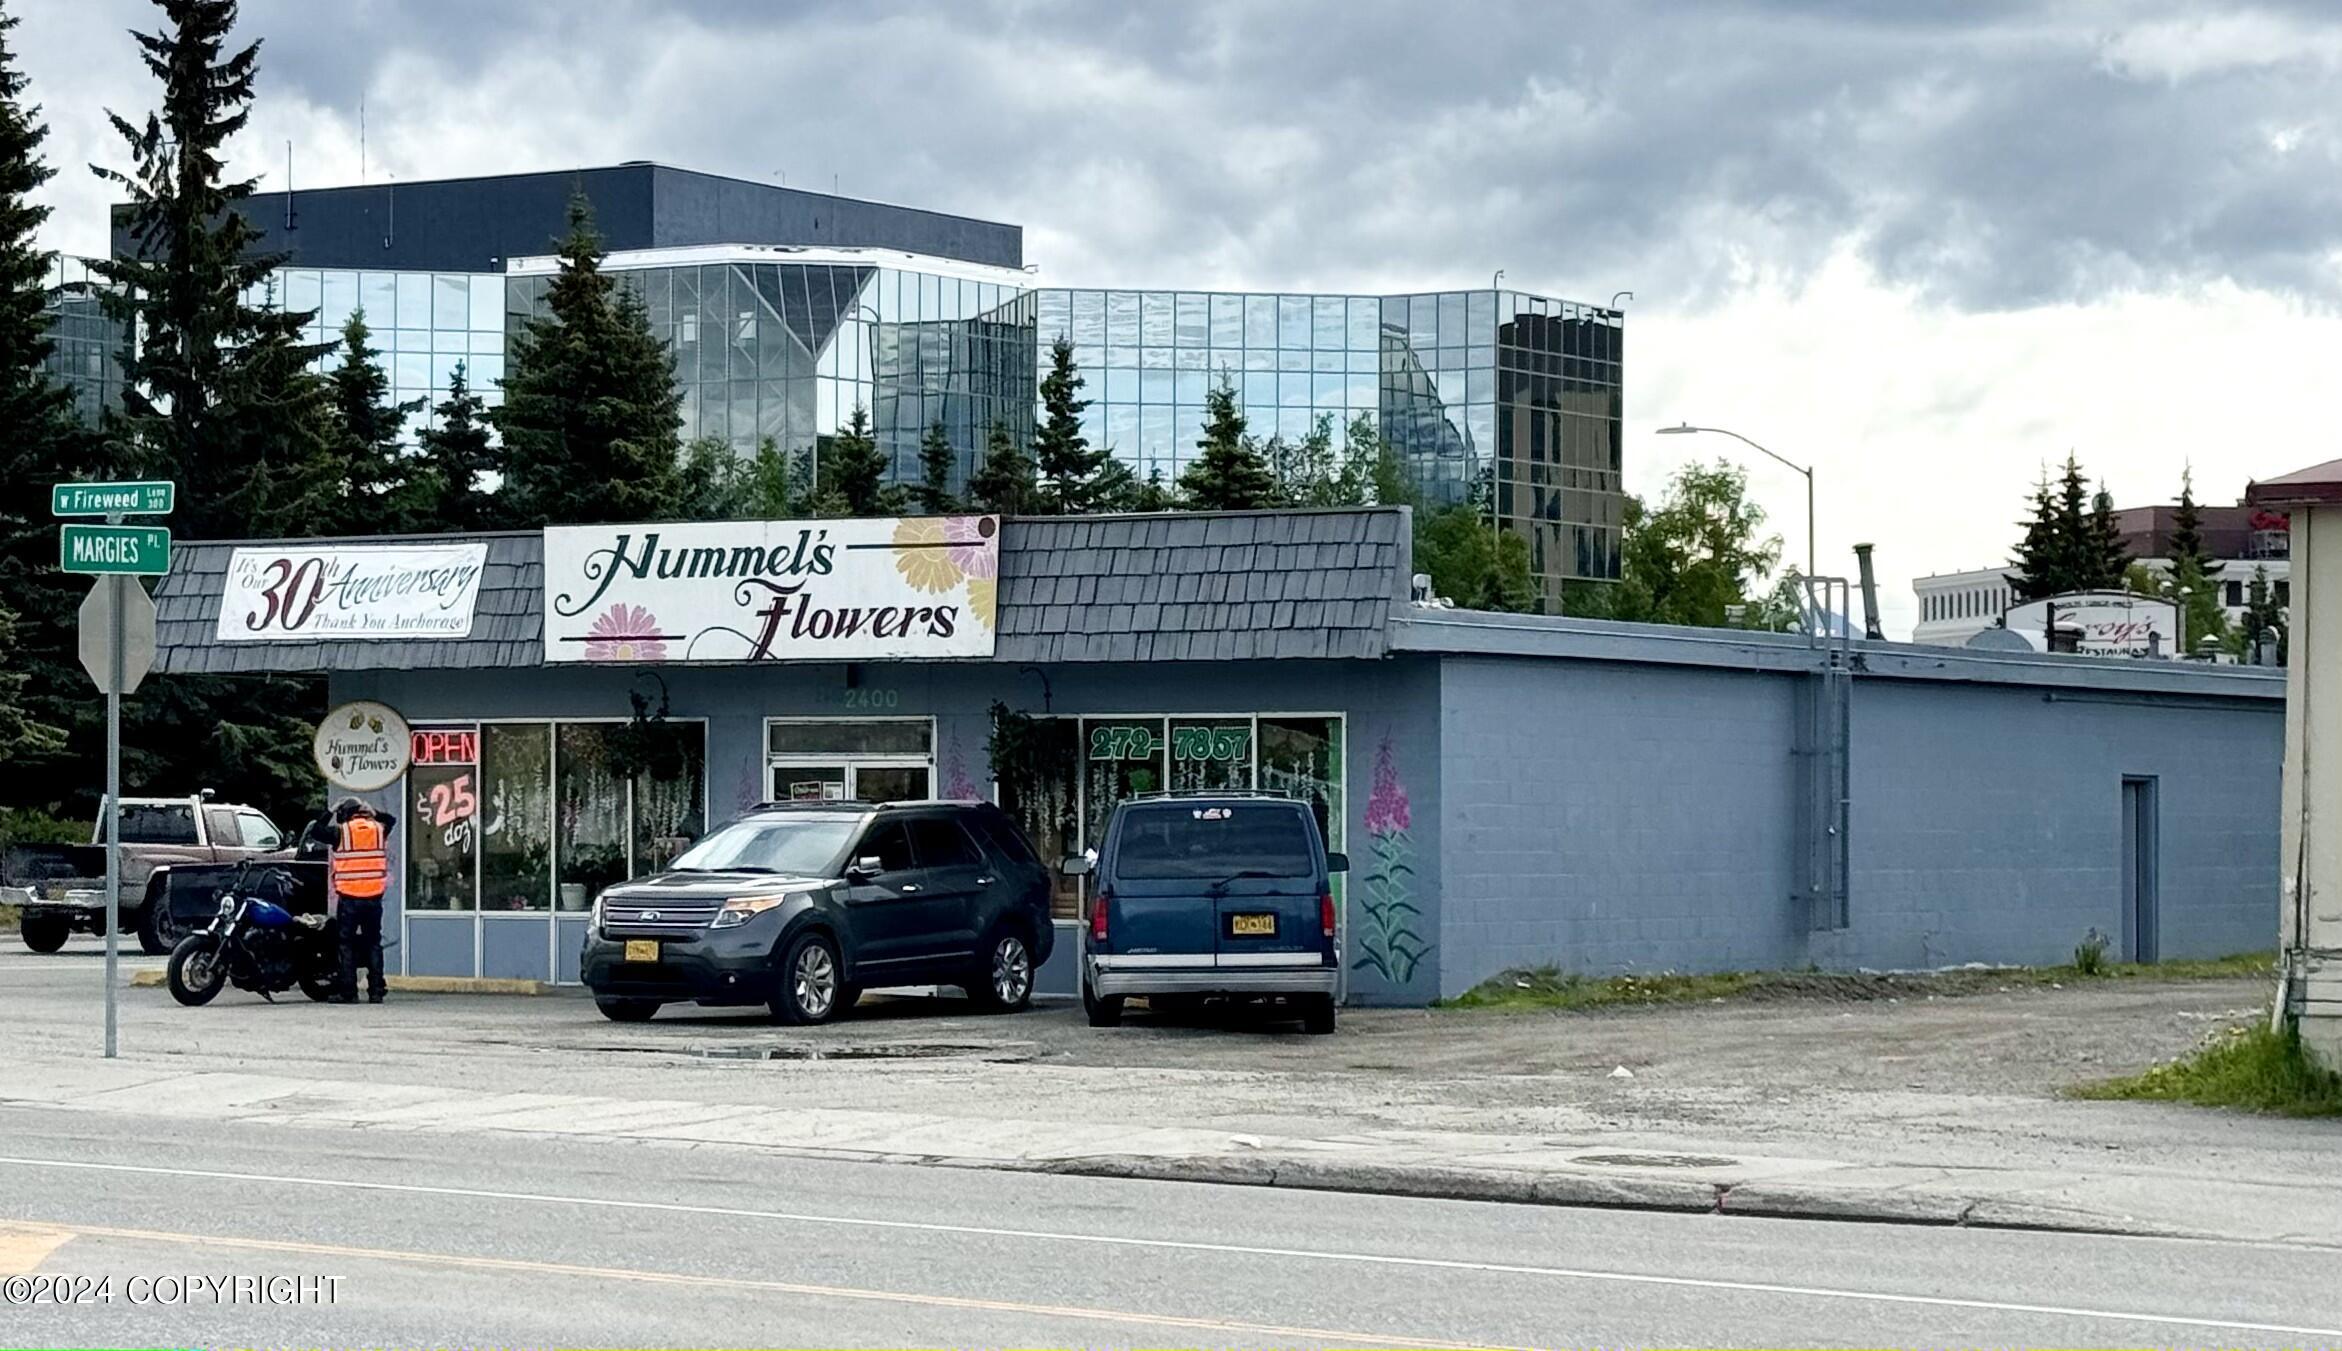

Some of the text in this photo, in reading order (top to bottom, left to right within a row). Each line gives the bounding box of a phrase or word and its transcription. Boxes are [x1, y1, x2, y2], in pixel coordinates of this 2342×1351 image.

[60, 495, 69, 509] W
[74, 489, 139, 509] Fireweed
[73, 534, 161, 563] MARGIES PL
[236, 557, 258, 574] It's
[555, 529, 836, 617] Hummel's
[241, 574, 268, 590] Our
[315, 562, 479, 610] Anniversary
[314, 613, 464, 630] Thank You Anchorage
[735, 577, 958, 661] Flowers
[845, 689, 898, 709] 2400
[325, 736, 390, 757] Hummel's
[411, 733, 477, 763] OPEN
[347, 754, 398, 775] Flowers
[444, 816, 473, 854] doz
